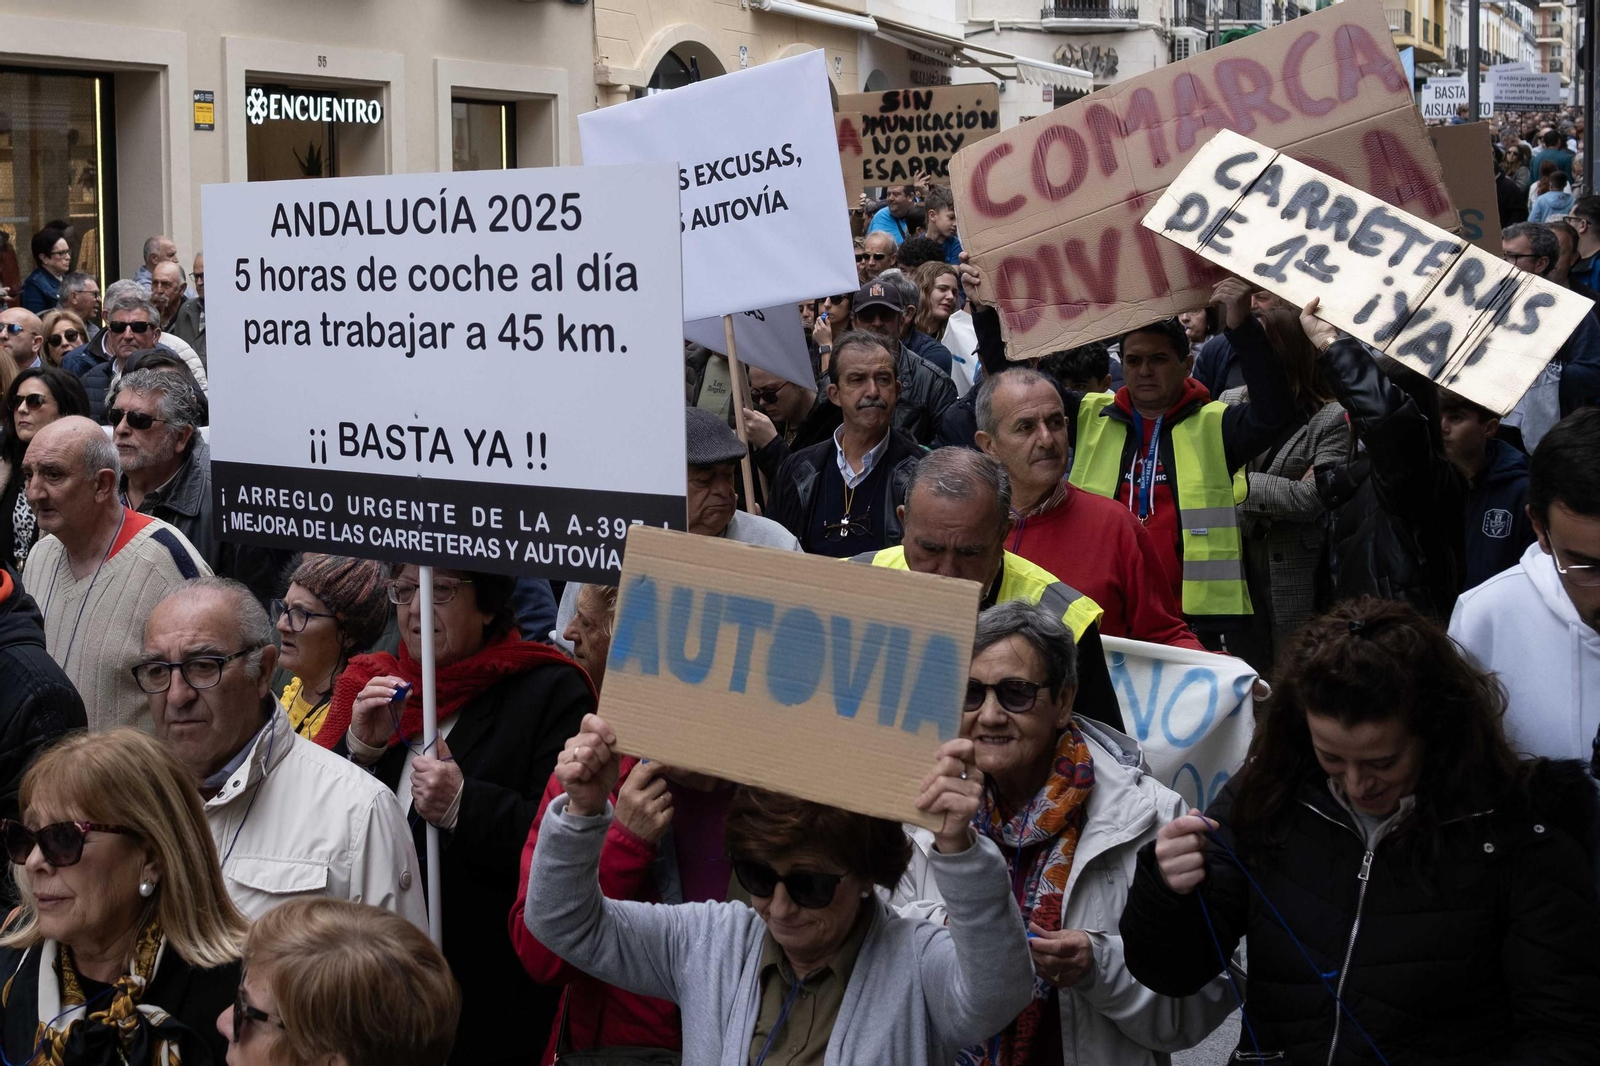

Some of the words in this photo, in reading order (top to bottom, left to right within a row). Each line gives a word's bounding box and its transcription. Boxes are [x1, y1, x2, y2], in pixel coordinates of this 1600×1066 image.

[317, 55, 328, 68] 55
[269, 94, 381, 124] ENCUENTRO
[879, 90, 933, 113] SIN
[1434, 86, 1466, 99] BASTA
[971, 24, 1407, 218] COMARCA
[694, 143, 802, 186] EXCUSAS,
[872, 134, 911, 155] NO
[917, 132, 965, 154] HAY
[271, 188, 476, 238] ANDALUCÍA
[488, 192, 582, 232] 2025
[691, 184, 789, 230] AUTOVÍA
[1163, 191, 1247, 254] DE
[235, 258, 251, 292] 5
[260, 257, 346, 292] horas
[357, 255, 397, 292] de
[408, 254, 518, 292] coche
[531, 253, 563, 292] al
[577, 252, 638, 292] día
[244, 319, 311, 353] para
[320, 311, 455, 358] trabajar
[466, 322, 487, 350] a
[498, 313, 544, 351] 45
[558, 313, 628, 353] km.
[339, 421, 454, 465] BASTA
[464, 428, 513, 469] YA
[237, 485, 334, 513] ARREGLO
[347, 495, 456, 525] URGENTE
[472, 506, 503, 529] DE
[519, 510, 550, 533] LA
[566, 514, 645, 539] A-39
[303, 519, 326, 540] DE
[330, 522, 365, 544] LAS
[369, 526, 500, 559] CARRETERAS
[505, 539, 519, 561] Y
[607, 574, 962, 742] AUTOVIA
